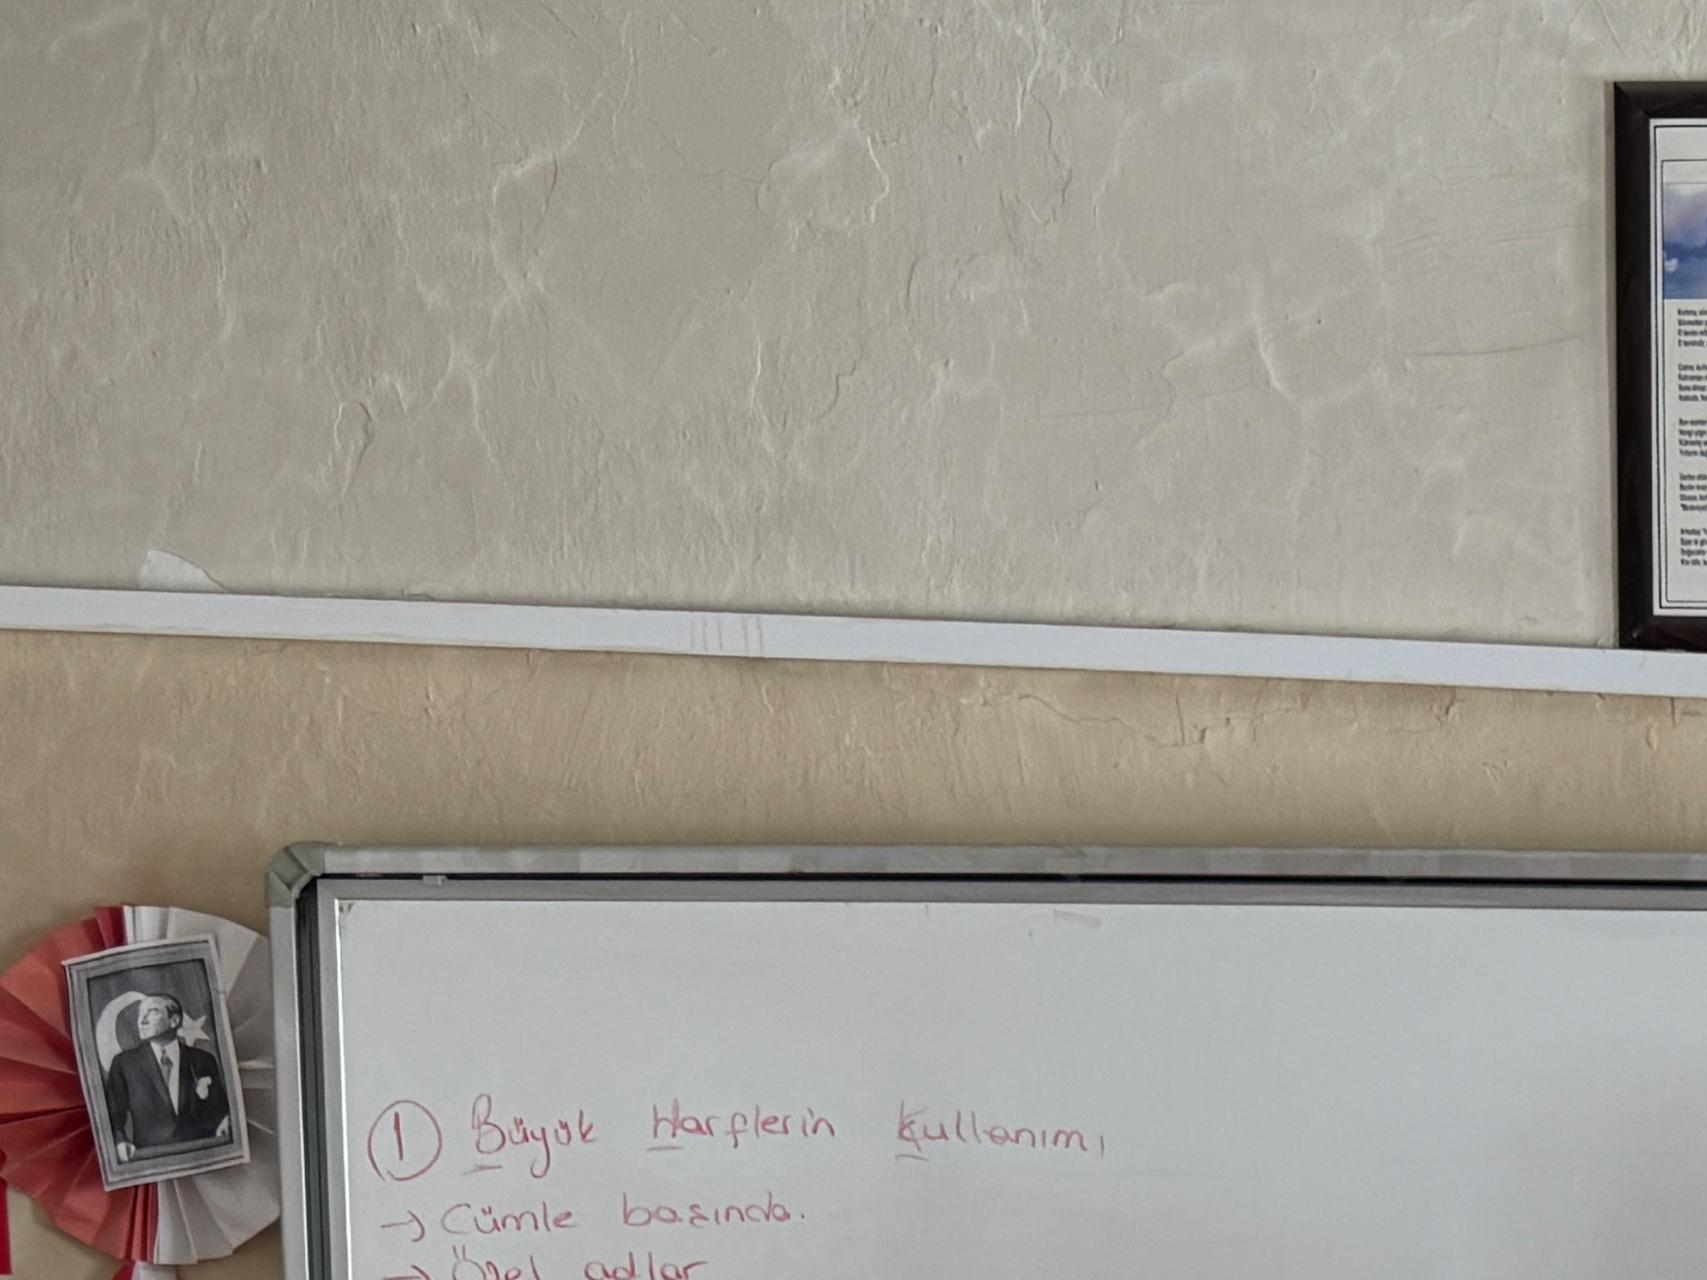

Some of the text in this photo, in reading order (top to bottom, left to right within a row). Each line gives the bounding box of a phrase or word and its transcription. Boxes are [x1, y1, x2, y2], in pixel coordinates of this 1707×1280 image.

[471, 1093, 1105, 1179] Büyük Harflerin Kullanımı
[441, 1201, 578, 1235] Cümle
